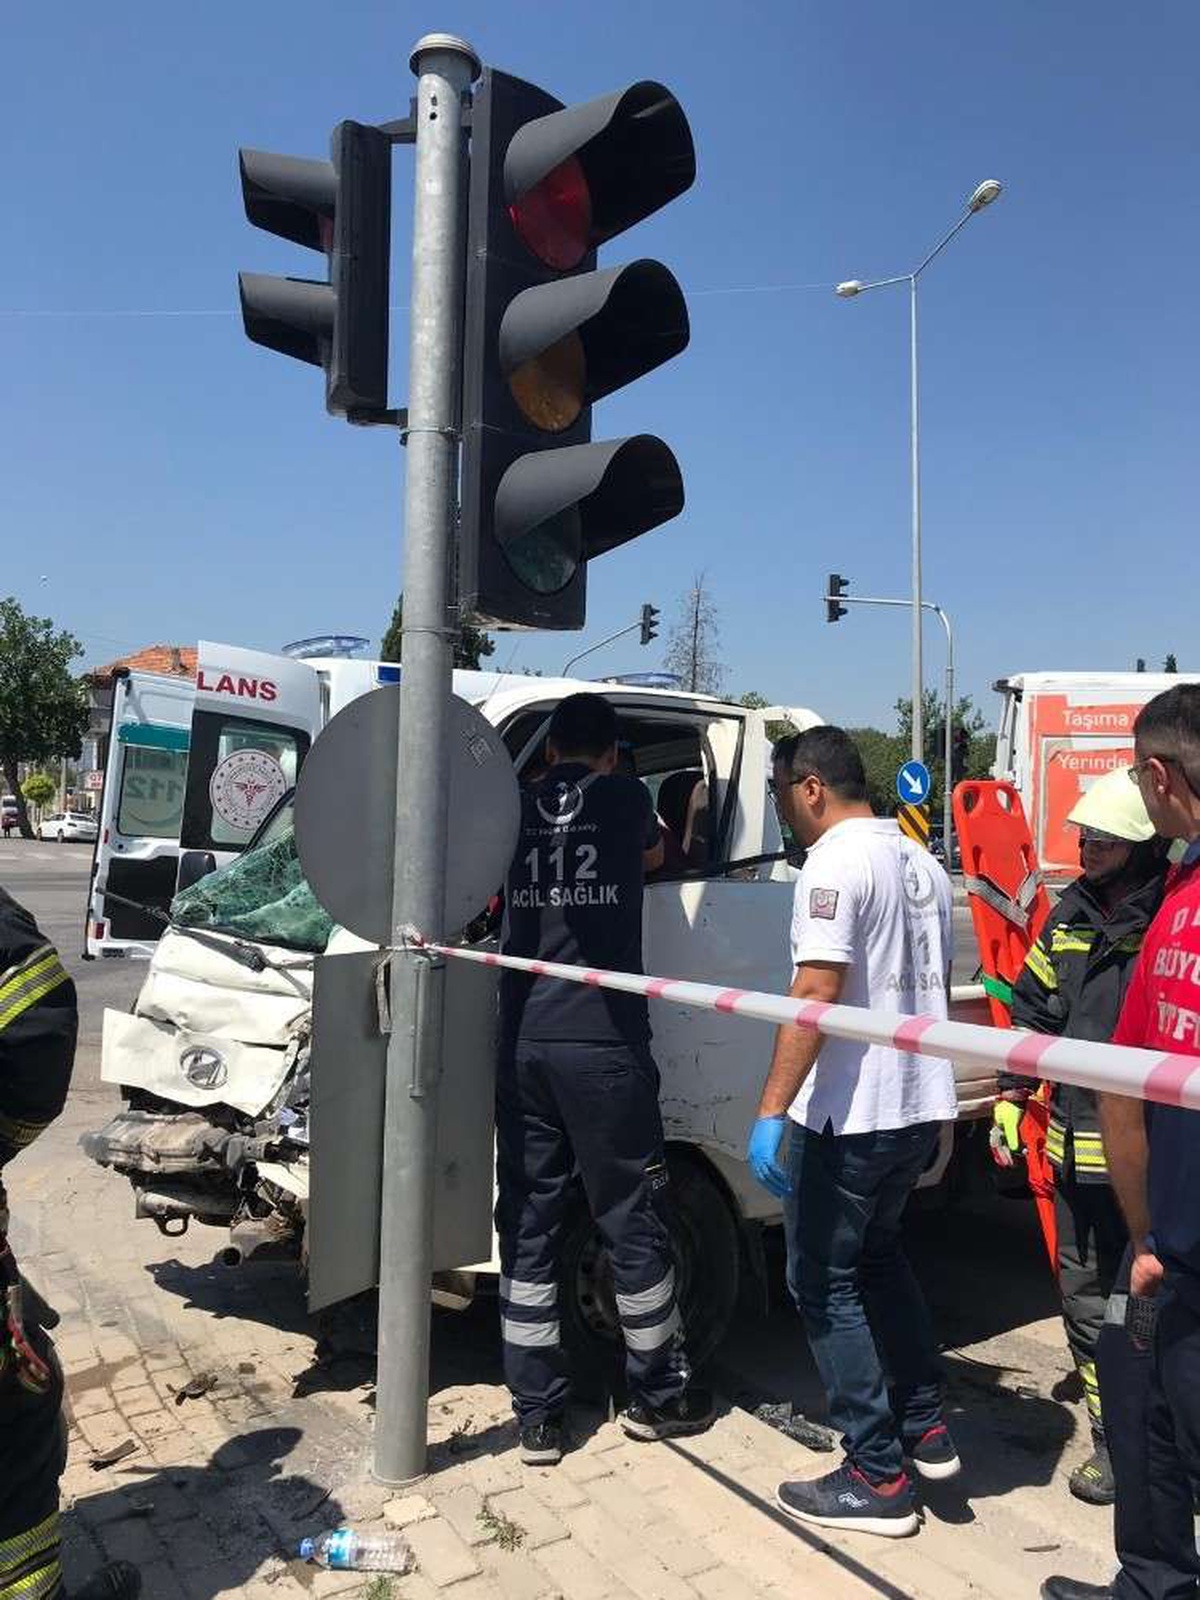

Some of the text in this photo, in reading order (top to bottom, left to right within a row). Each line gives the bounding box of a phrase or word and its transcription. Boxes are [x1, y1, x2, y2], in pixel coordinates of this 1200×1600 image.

[197, 671, 277, 701] LANS
[1062, 710, 1129, 730] Taşıma
[525, 844, 598, 882] 112
[549, 880, 619, 906] SAĞLIK
